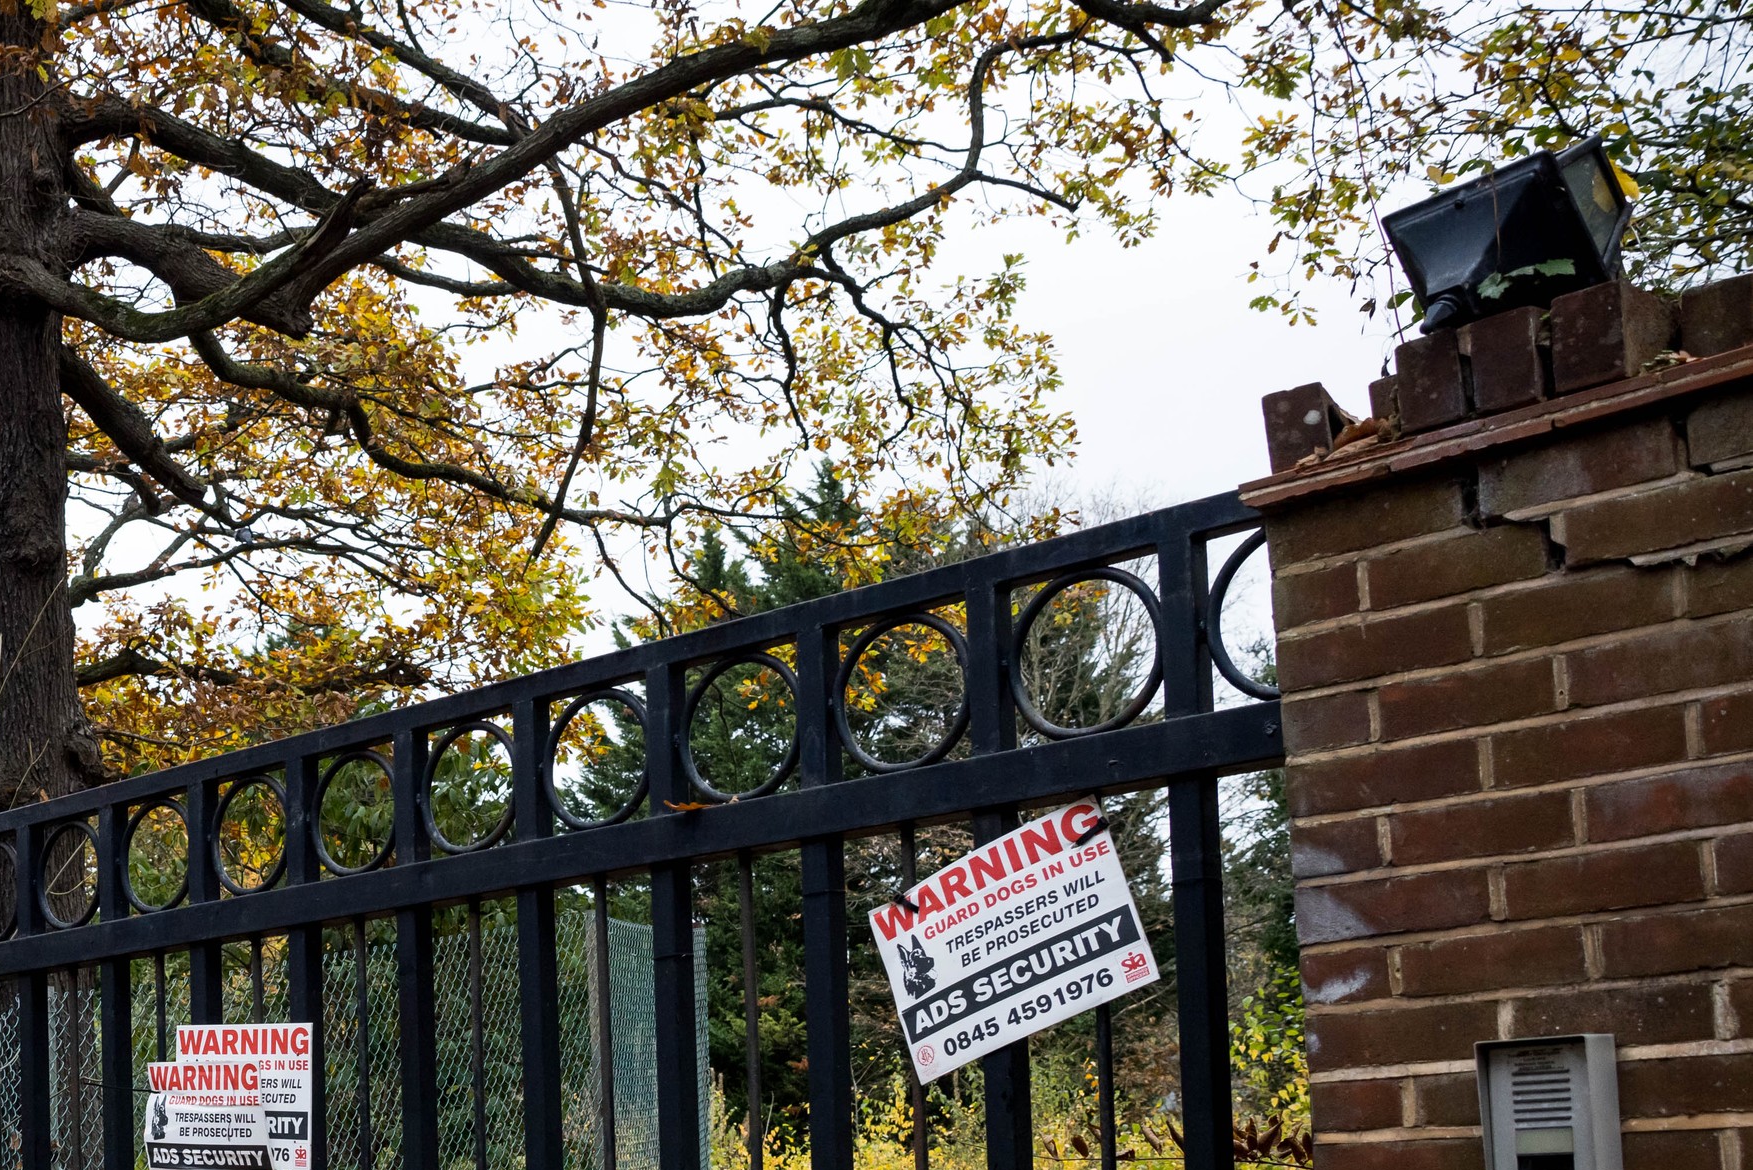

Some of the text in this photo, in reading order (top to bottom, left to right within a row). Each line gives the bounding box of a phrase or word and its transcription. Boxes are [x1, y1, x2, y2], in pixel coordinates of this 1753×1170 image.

[873, 804, 1103, 941] WARNING
[924, 841, 1110, 940] GUARD DOGS IN USE
[946, 871, 1105, 954] TRESPASSERS WILL
[961, 894, 1100, 967] BE PROSECUTED
[915, 916, 1123, 1034] ADS SECURITY
[944, 1018, 1000, 1056] 0845
[1007, 968, 1113, 1026] 4591976
[179, 1027, 309, 1055] WARNING
[275, 1061, 284, 1070] IN
[289, 1060, 308, 1070] USE
[150, 1064, 258, 1091] WARNING
[282, 1079, 302, 1089] WILL
[169, 1095, 259, 1106] GUARD DOGS IN USE
[262, 1094, 296, 1103] ECUTED
[175, 1113, 256, 1123] TRESPASSERS WILL
[267, 1117, 303, 1134] RITY
[180, 1128, 252, 1138] BE PROSECUTED
[153, 1148, 179, 1164] ADS
[183, 1149, 263, 1166] SECURITY
